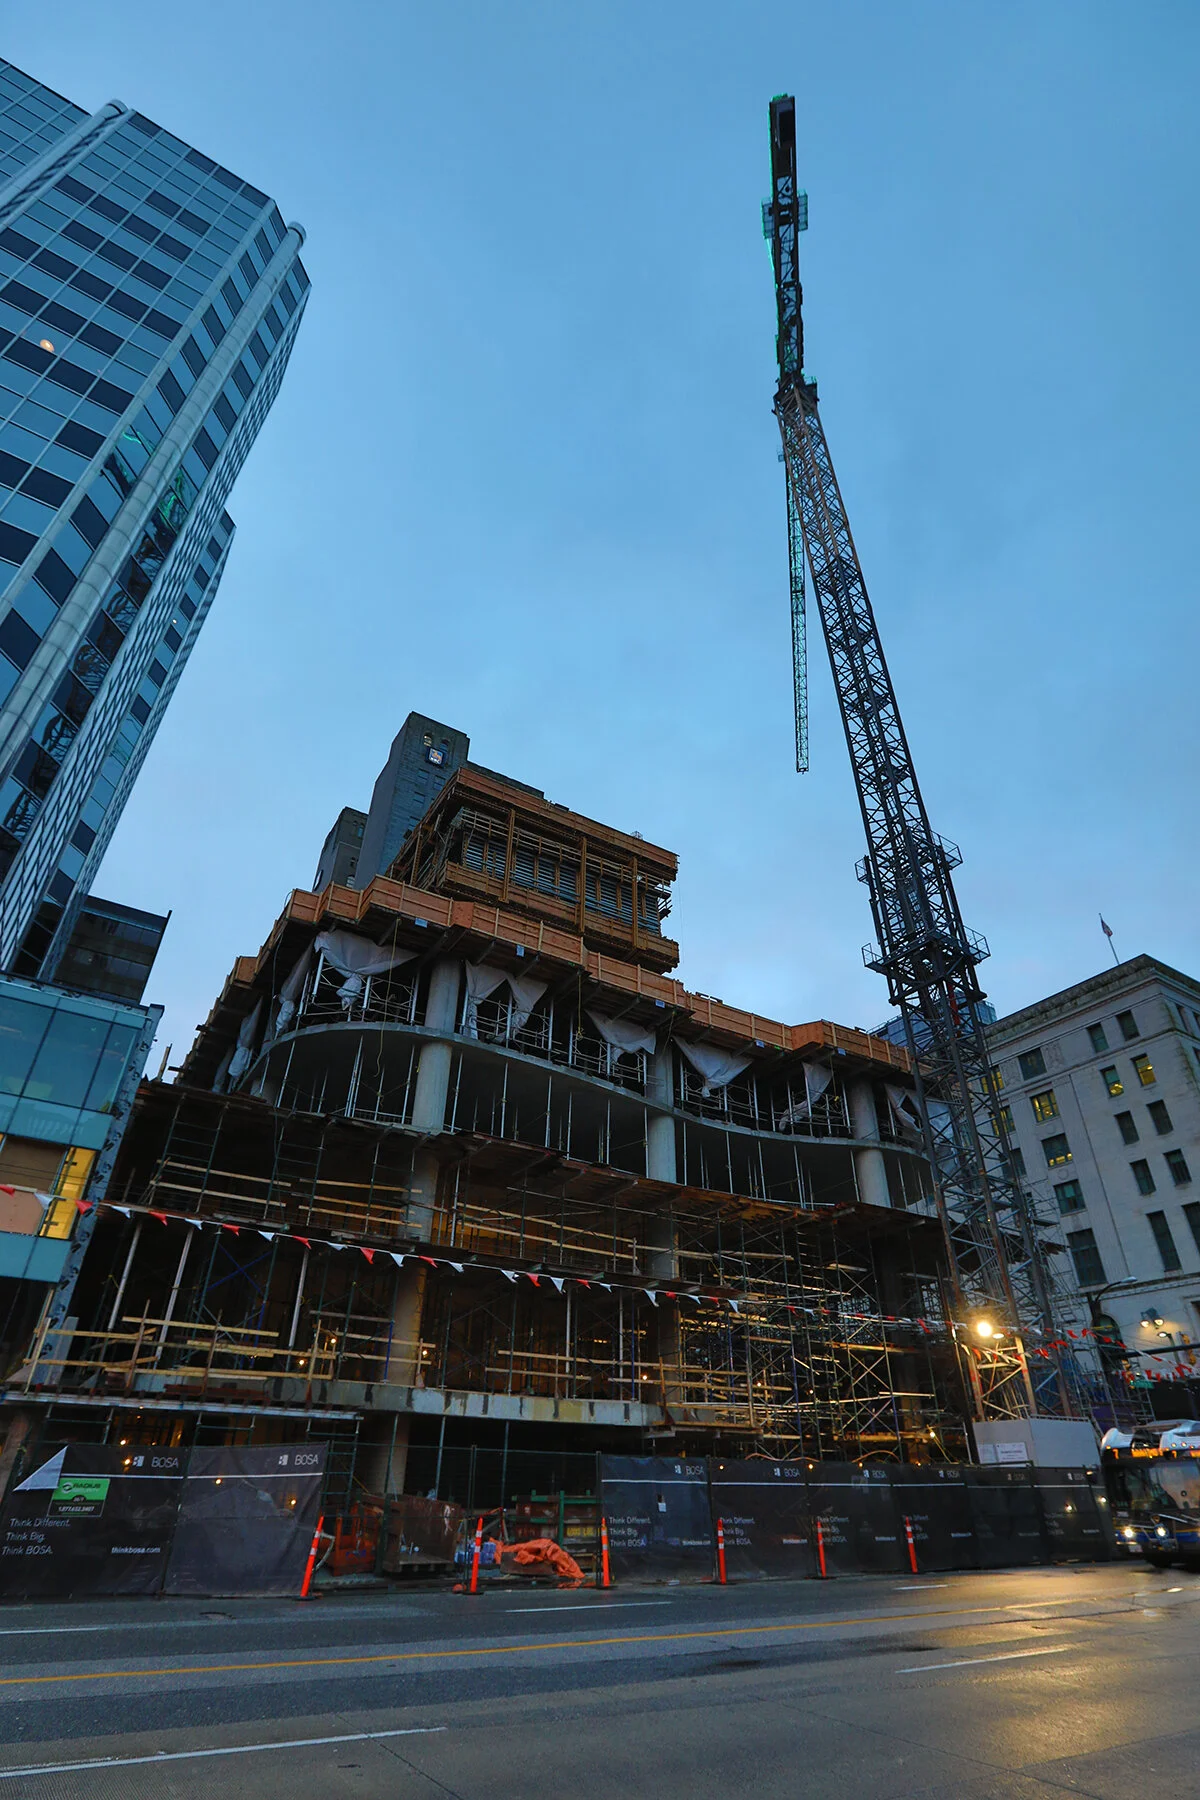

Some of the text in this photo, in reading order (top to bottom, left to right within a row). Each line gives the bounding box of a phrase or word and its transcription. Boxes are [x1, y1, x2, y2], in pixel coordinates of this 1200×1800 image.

[151, 1456, 179, 1468] BOSA
[294, 1454, 319, 1466] BOSA
[685, 1465, 705, 1476] BOSA
[783, 1468, 801, 1477] BOSA
[9, 1517, 32, 1528] Think
[6, 1531, 28, 1542] Think
[2, 1545, 24, 1556] Think
